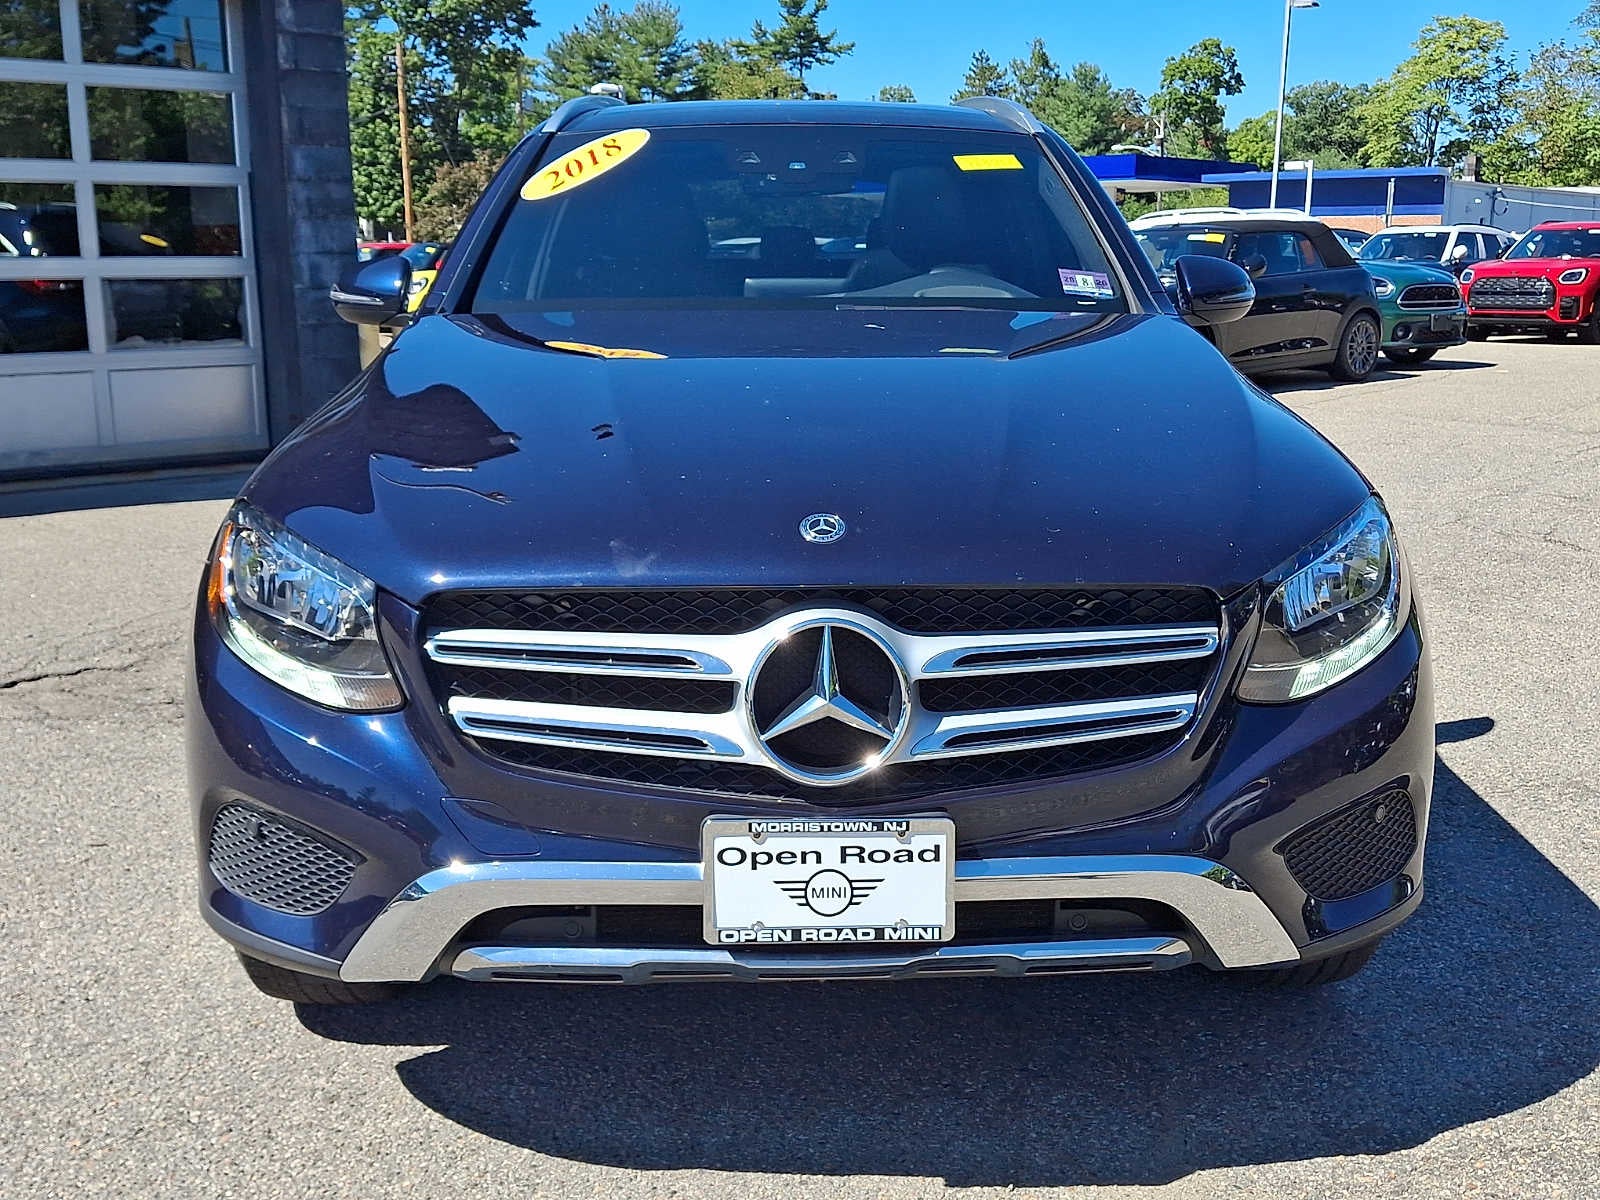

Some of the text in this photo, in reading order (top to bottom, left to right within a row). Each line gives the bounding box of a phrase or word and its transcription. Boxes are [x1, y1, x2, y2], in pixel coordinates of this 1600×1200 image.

[544, 138, 622, 191] 2018
[1081, 277, 1089, 287] 8
[751, 821, 907, 833] MORRISTOWN, NJ
[716, 844, 941, 870] Open Road
[811, 886, 847, 899] MINI
[719, 927, 940, 943] OPEN ROAD MINI
